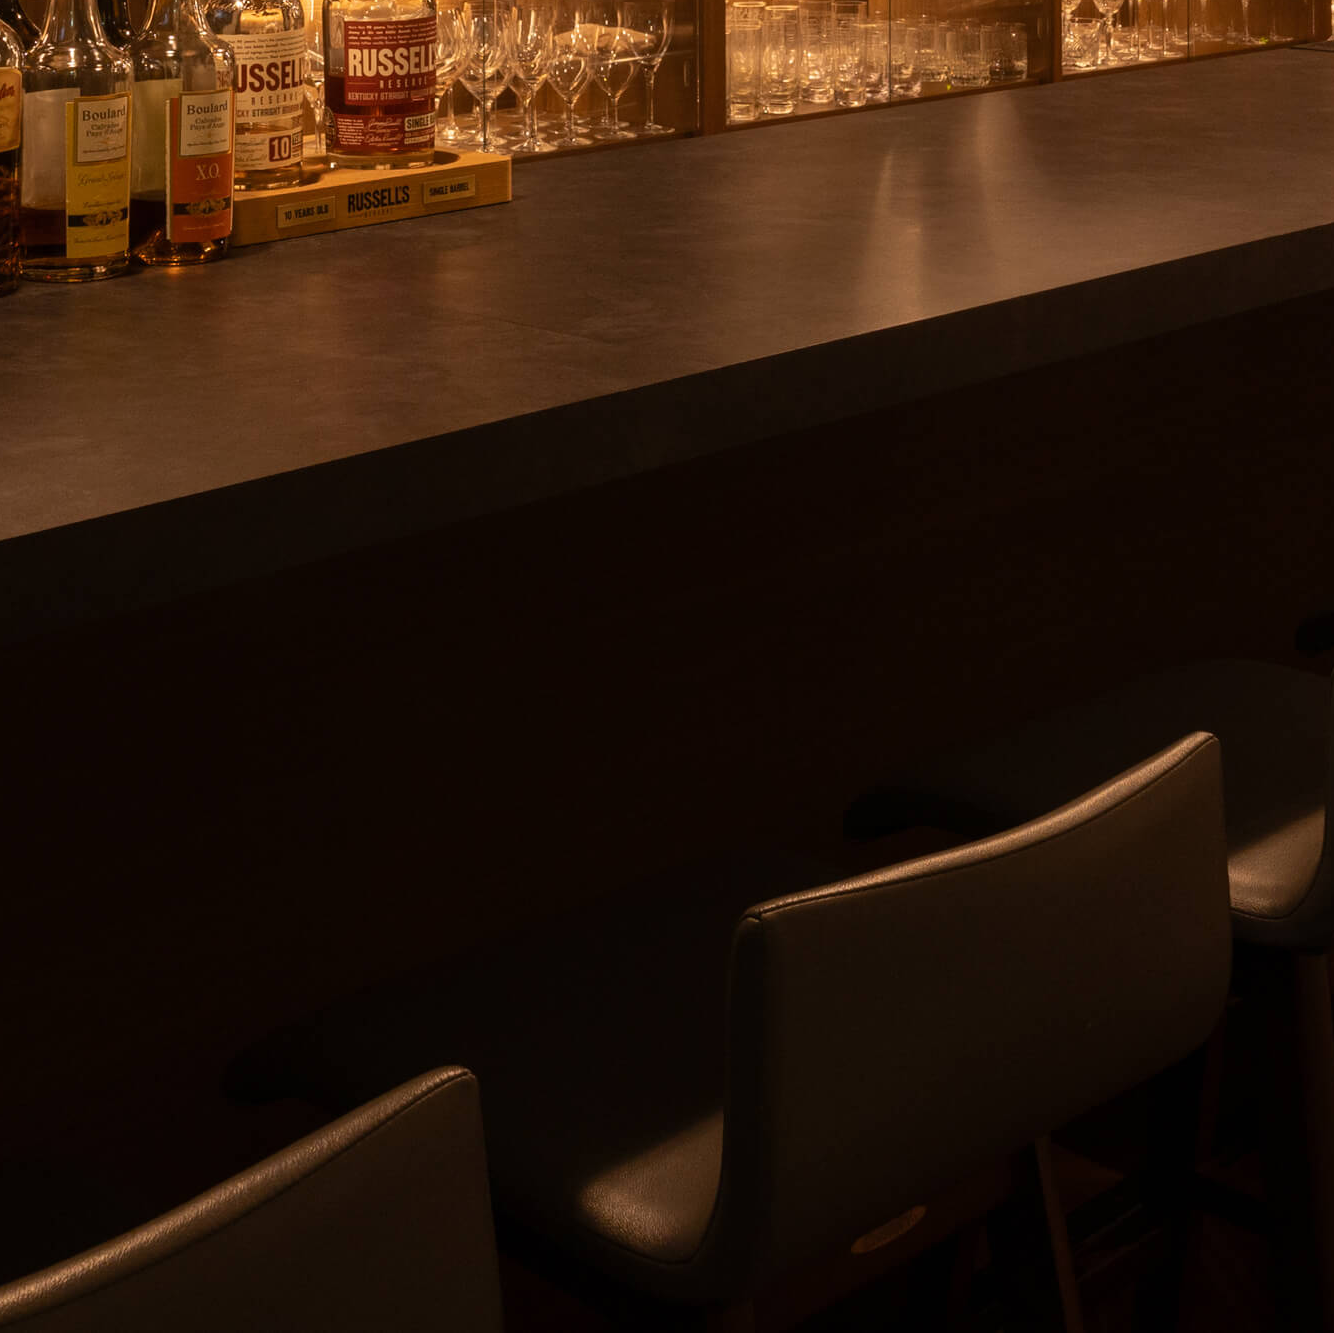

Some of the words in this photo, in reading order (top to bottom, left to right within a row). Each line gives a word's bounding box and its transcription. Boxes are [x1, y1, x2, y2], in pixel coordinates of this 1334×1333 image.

[82, 105, 126, 122] Boulard
[186, 100, 228, 115] Boulard
[271, 136, 291, 161] 10
[429, 184, 449, 196] SINGLE
[347, 185, 410, 213] RUSSELL'S
[283, 210, 293, 221] 10
[295, 207, 315, 219] YEARS
